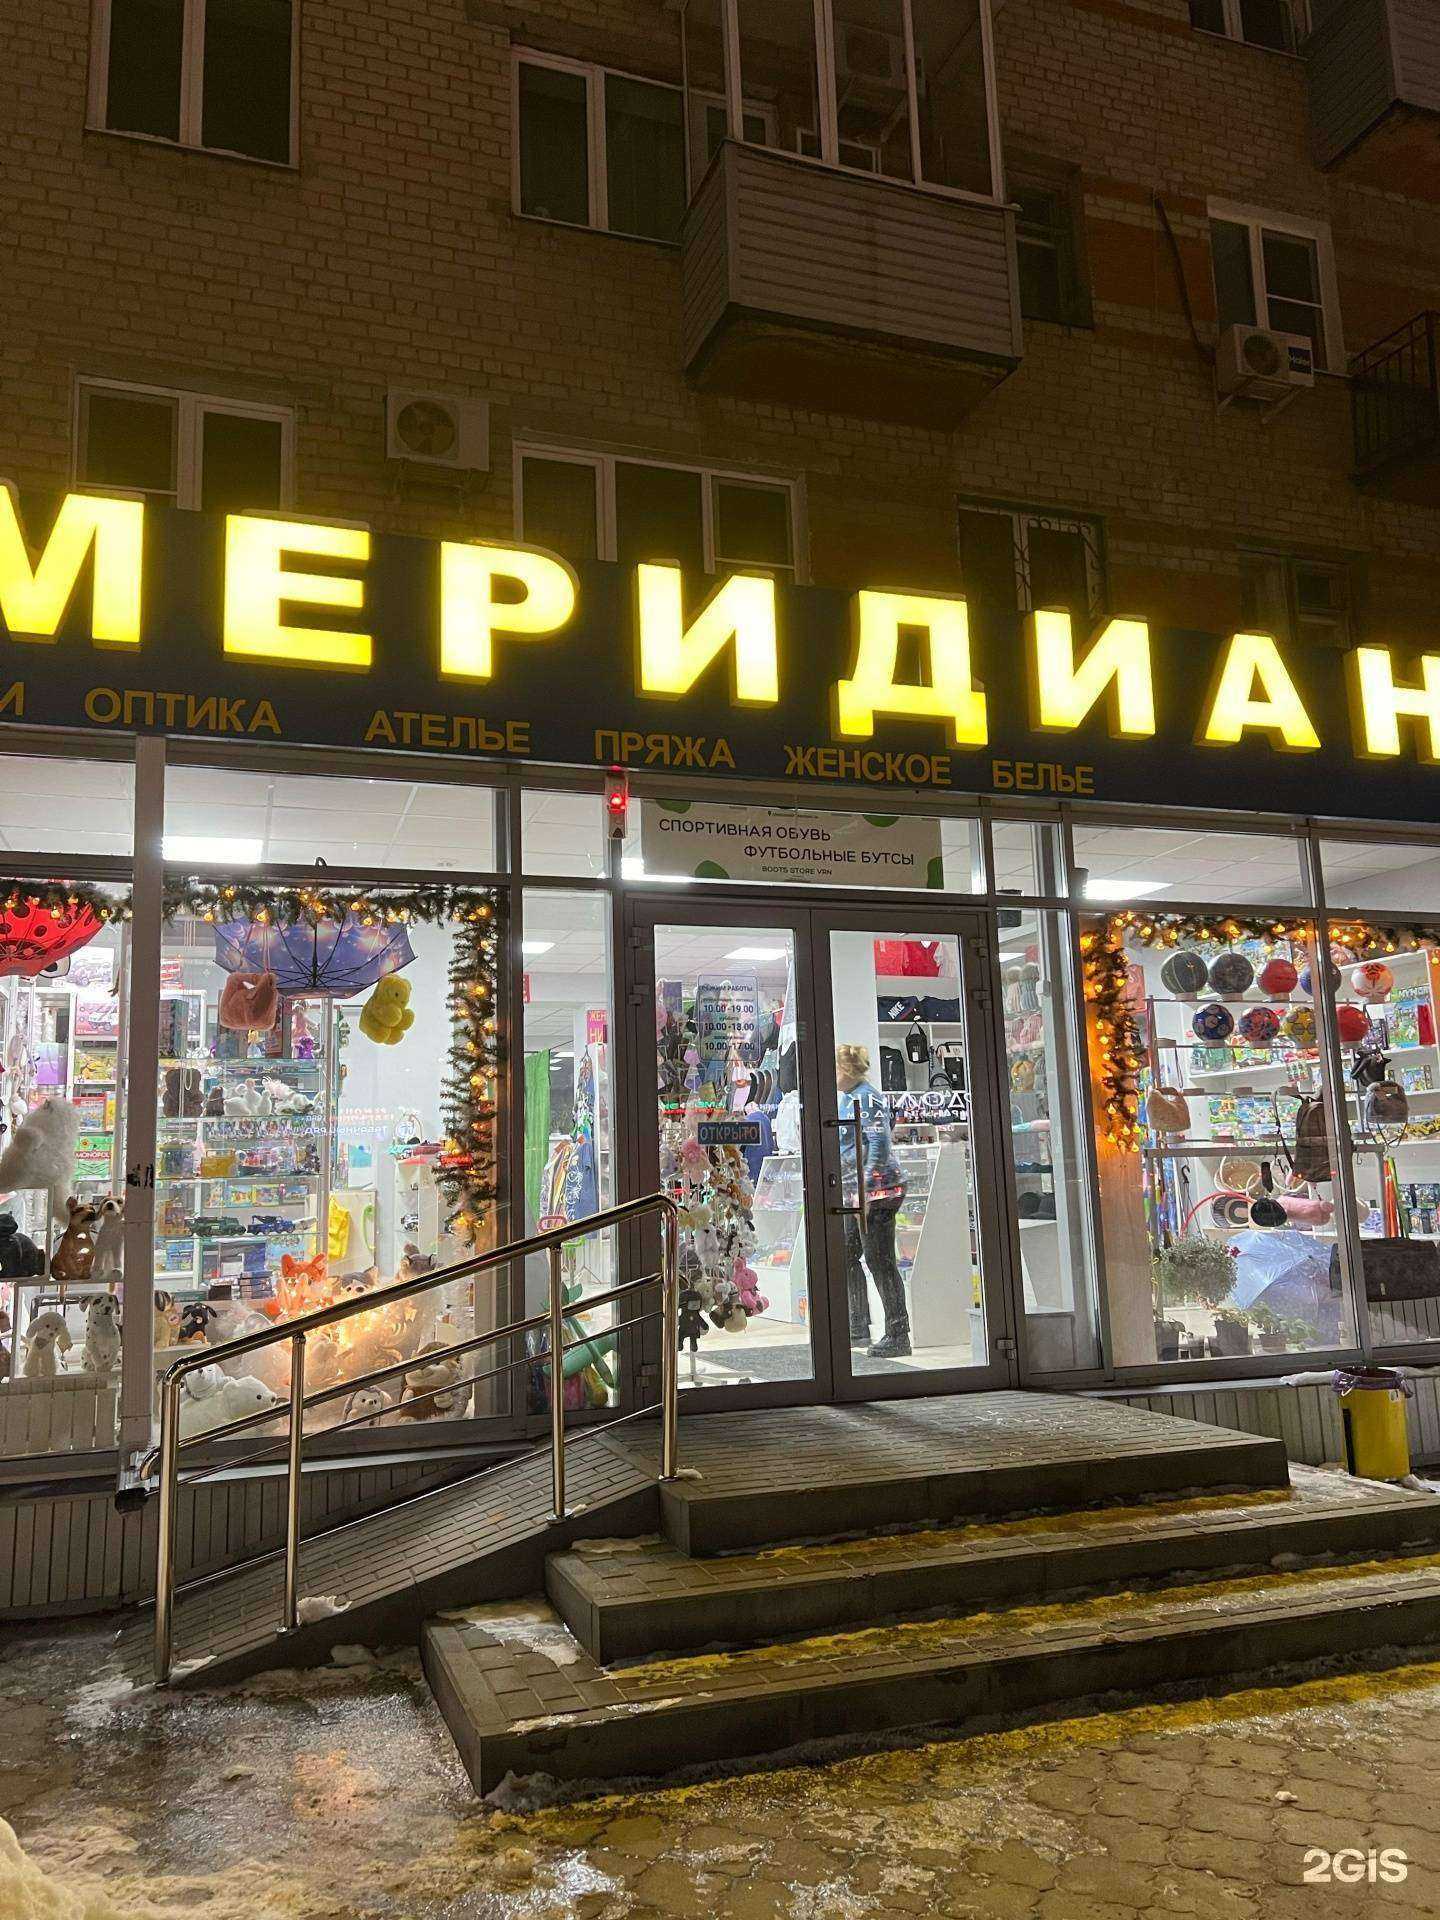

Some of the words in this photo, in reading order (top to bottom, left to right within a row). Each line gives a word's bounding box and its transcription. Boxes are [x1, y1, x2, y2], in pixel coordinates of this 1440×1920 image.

[0, 480, 1440, 764] МЕРИДИАН
[84, 686, 283, 735] ОПТИКА
[364, 709, 531, 753] АТЕЛЬЕ
[593, 729, 736, 769] ПРЯЖА
[783, 745, 952, 785] ЖЕНСКОЕ
[992, 759, 1096, 795] БЕЛЬЕ
[659, 818, 772, 839] СПОРТИВНАЯ
[776, 826, 831, 842] ОБУВЬ
[743, 845, 856, 863] ФУТБОЛЬНЫЕ
[861, 851, 914, 866] БУТСЫ
[761, 865, 789, 874] BOOTS
[790, 866, 814, 875] STORE
[887, 1001, 905, 1020] NIKE
[700, 1126, 757, 1139] ОТКРЫТО
